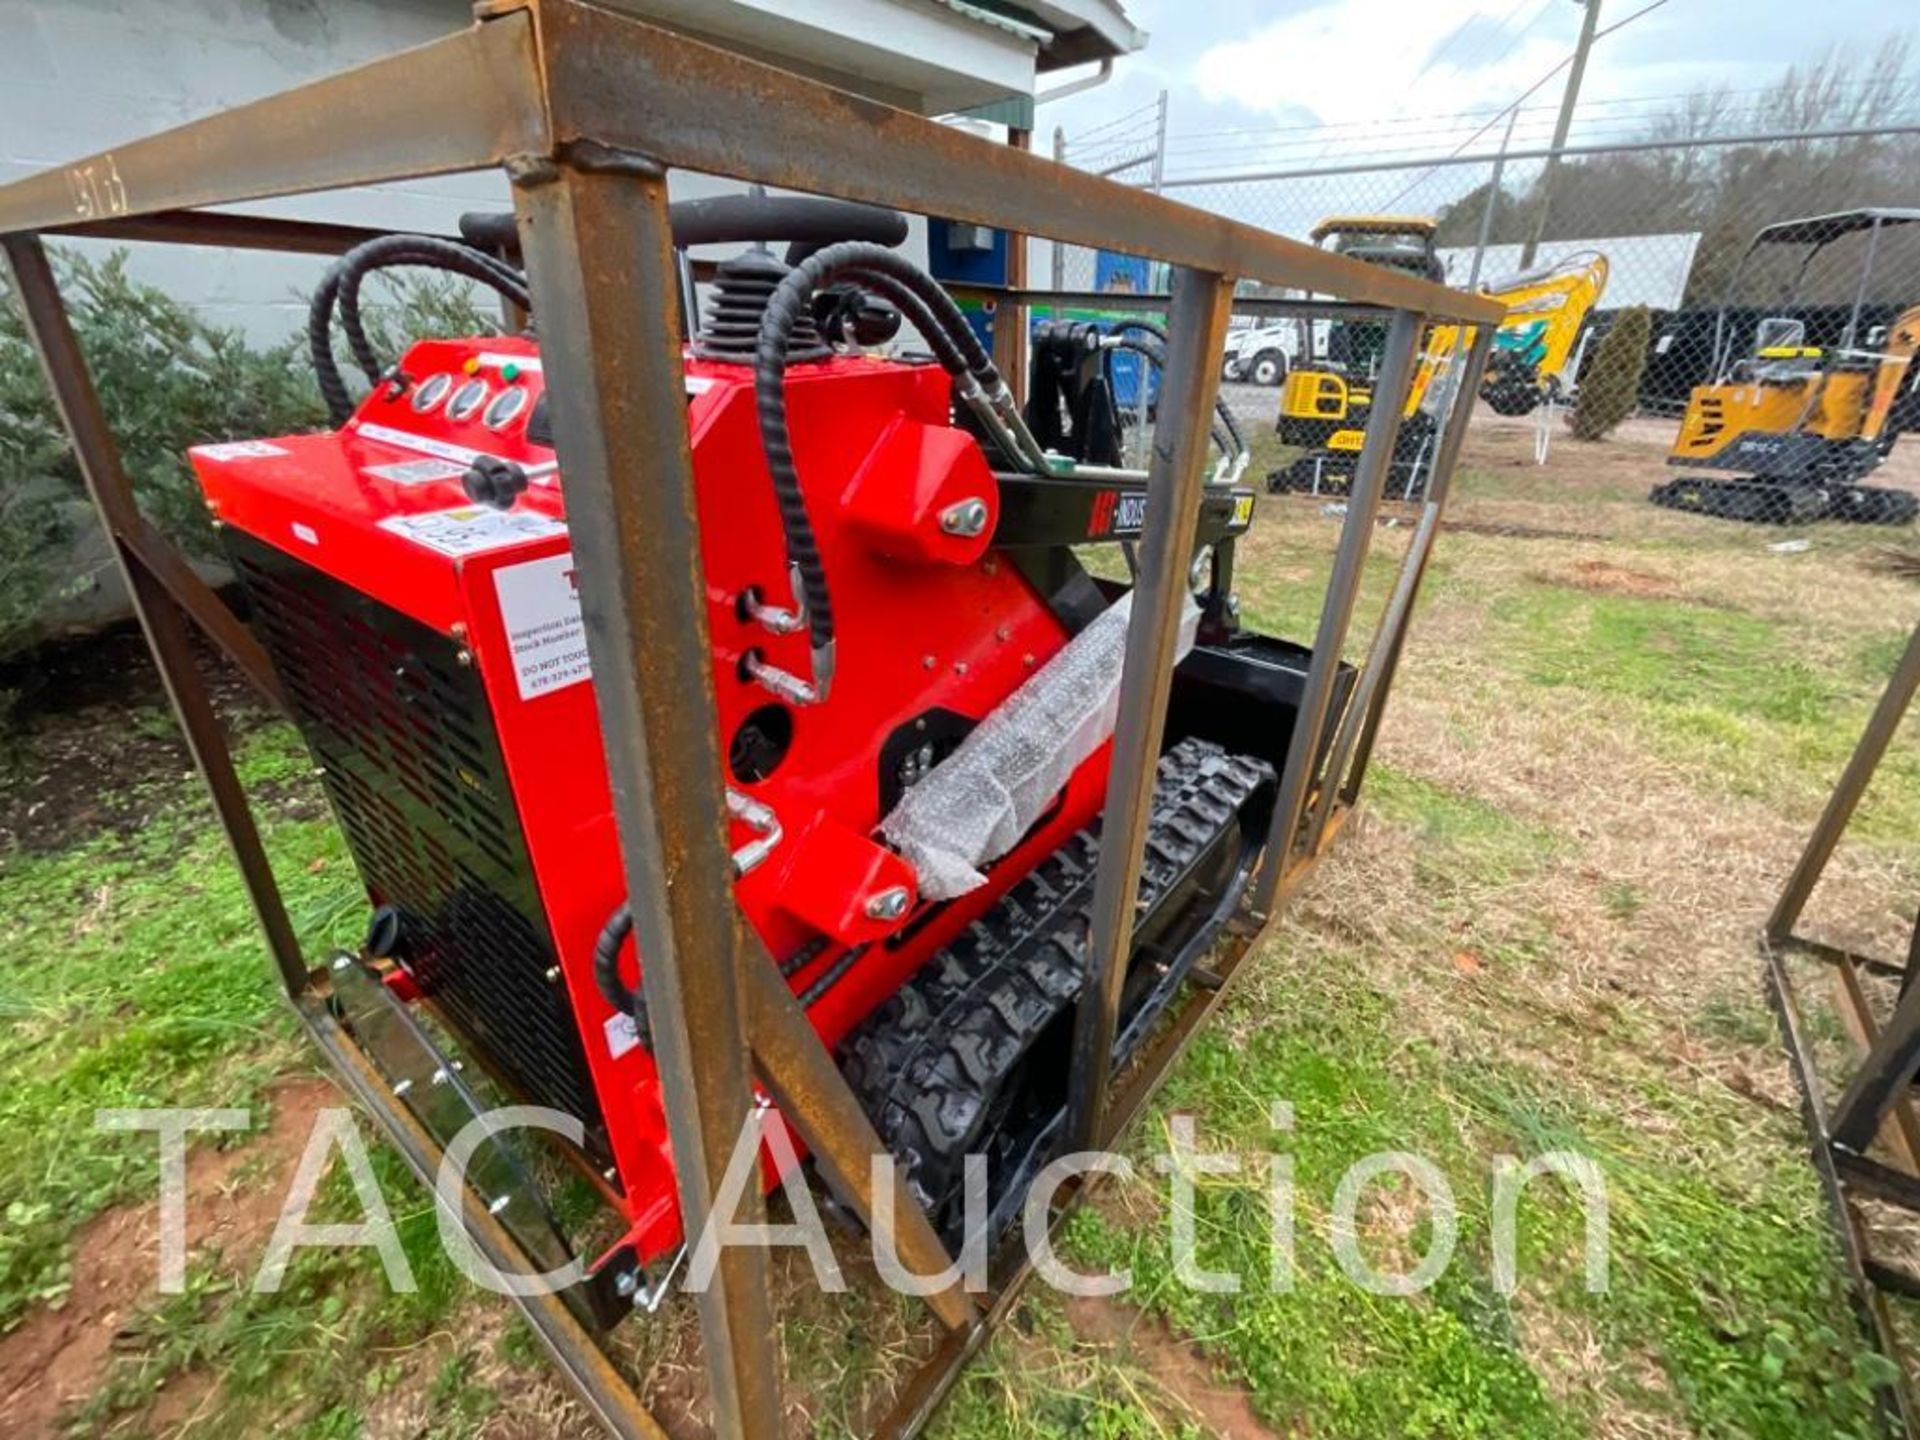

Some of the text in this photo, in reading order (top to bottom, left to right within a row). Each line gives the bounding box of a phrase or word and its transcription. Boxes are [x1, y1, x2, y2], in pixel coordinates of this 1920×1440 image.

[511, 620, 563, 640] Inspection
[514, 638, 540, 653] Stock
[521, 663, 539, 677] DO
[540, 657, 561, 672] NOT
